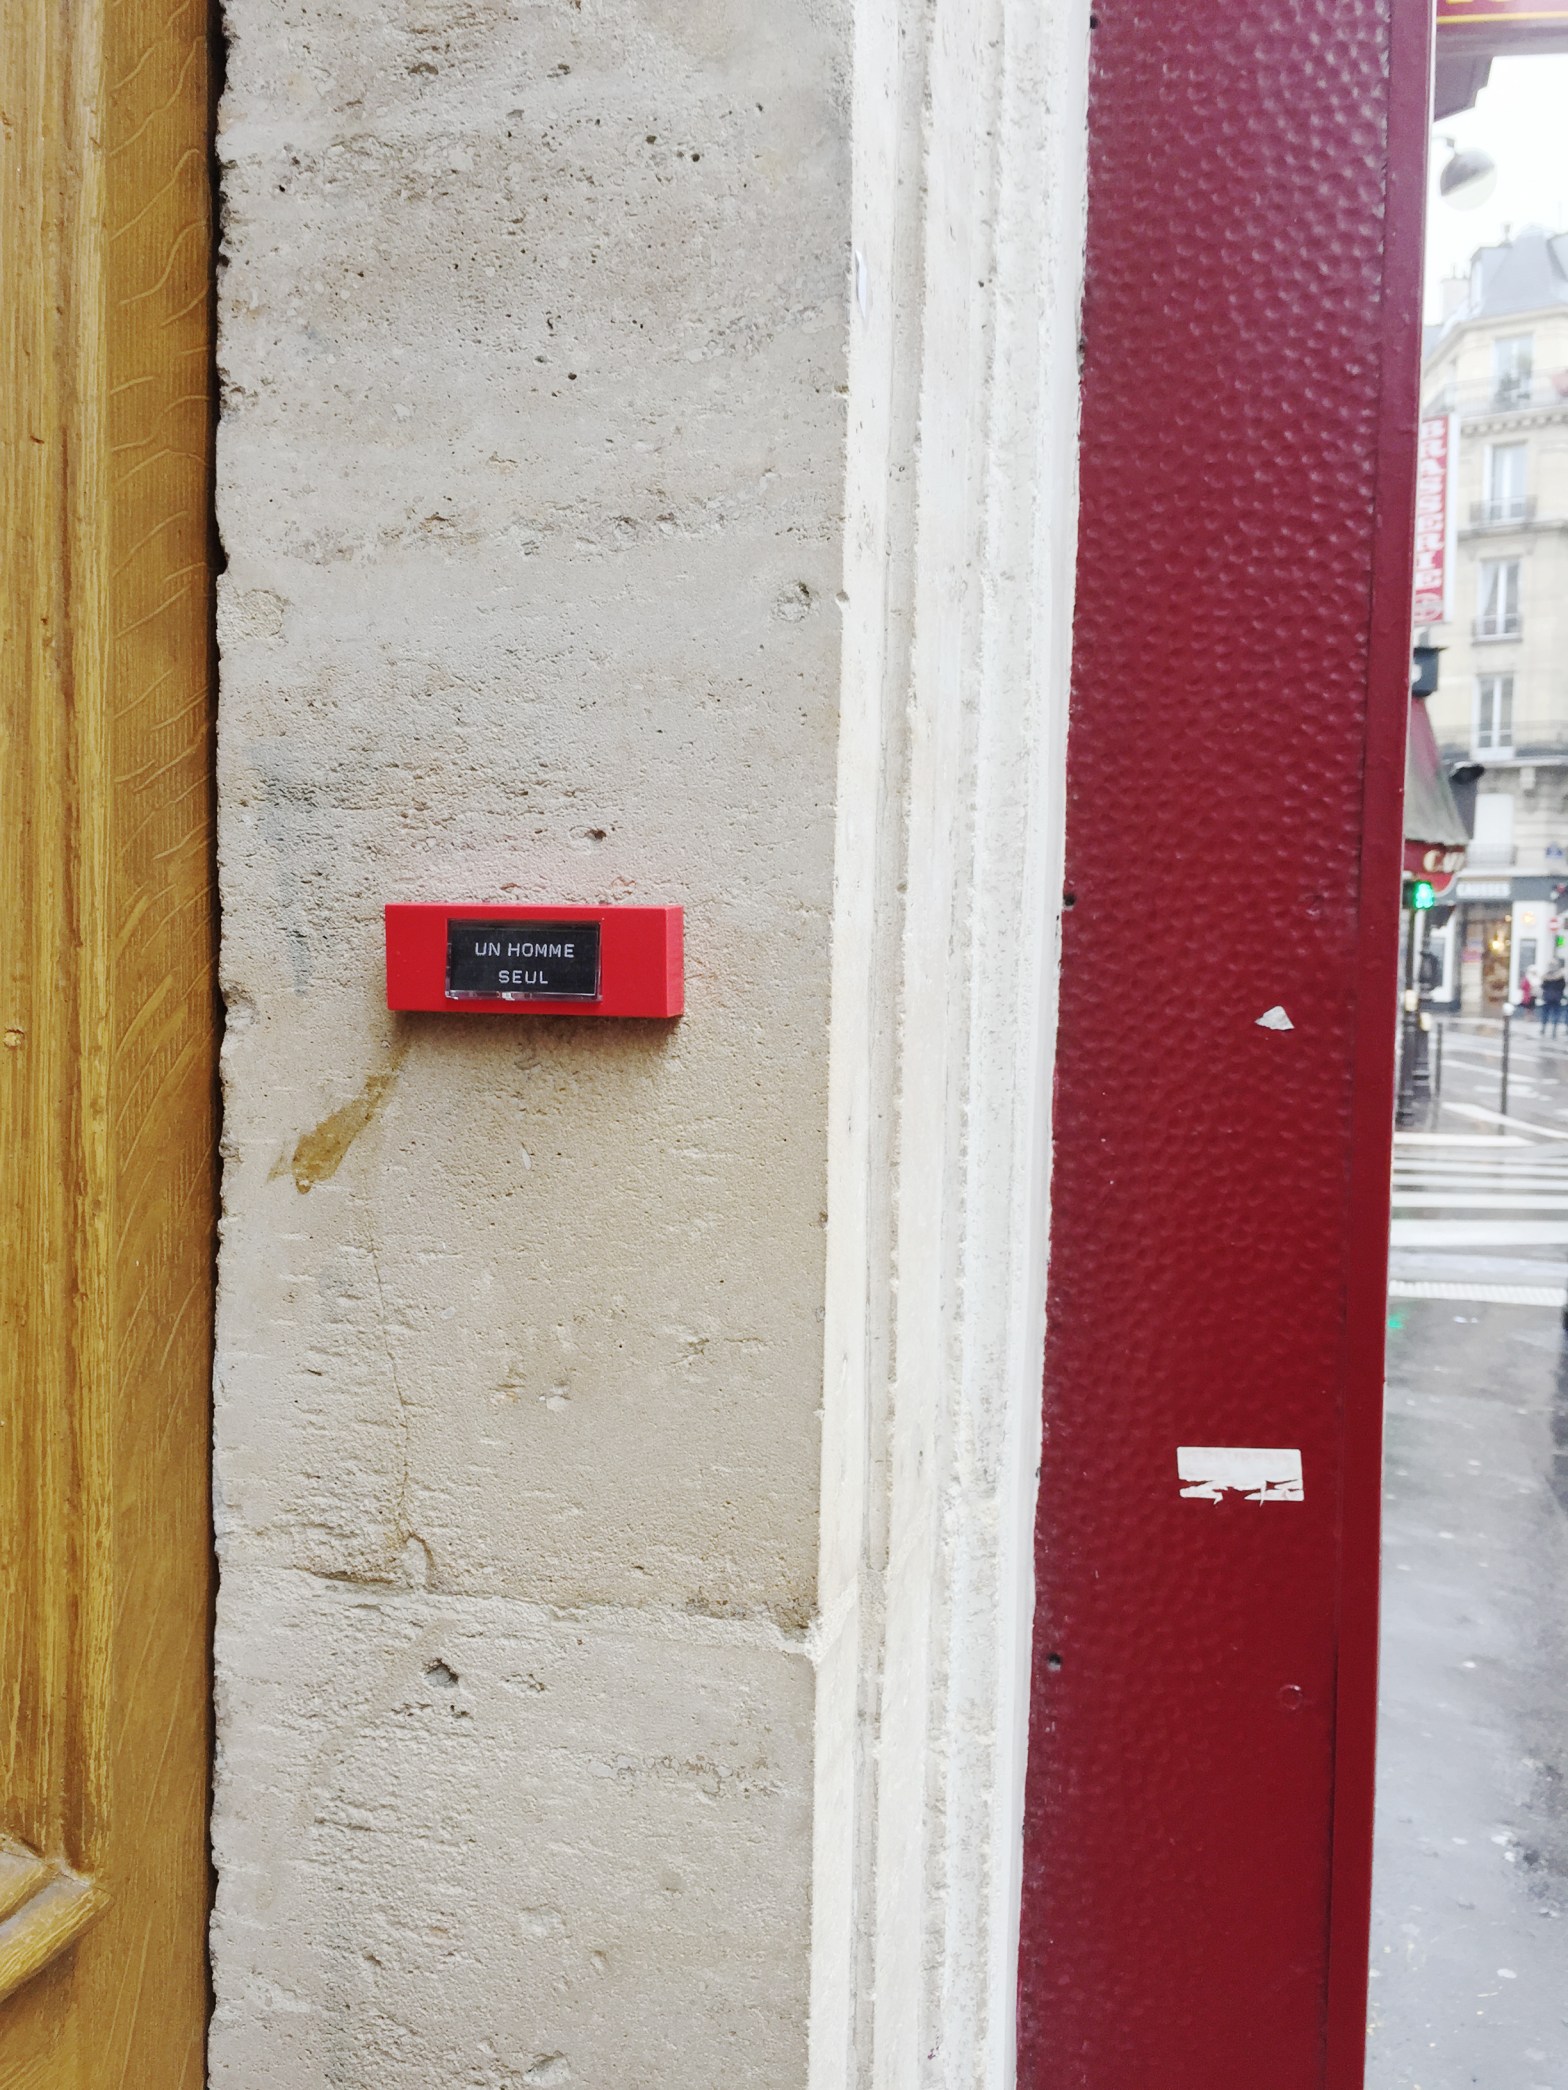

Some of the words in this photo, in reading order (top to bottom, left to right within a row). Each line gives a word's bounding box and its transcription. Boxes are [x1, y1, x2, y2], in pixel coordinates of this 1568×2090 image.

[1415, 420, 1447, 589] BRASSERIE
[475, 942, 500, 957] UN
[507, 942, 575, 958] HOMME
[498, 969, 549, 984] SEUL
